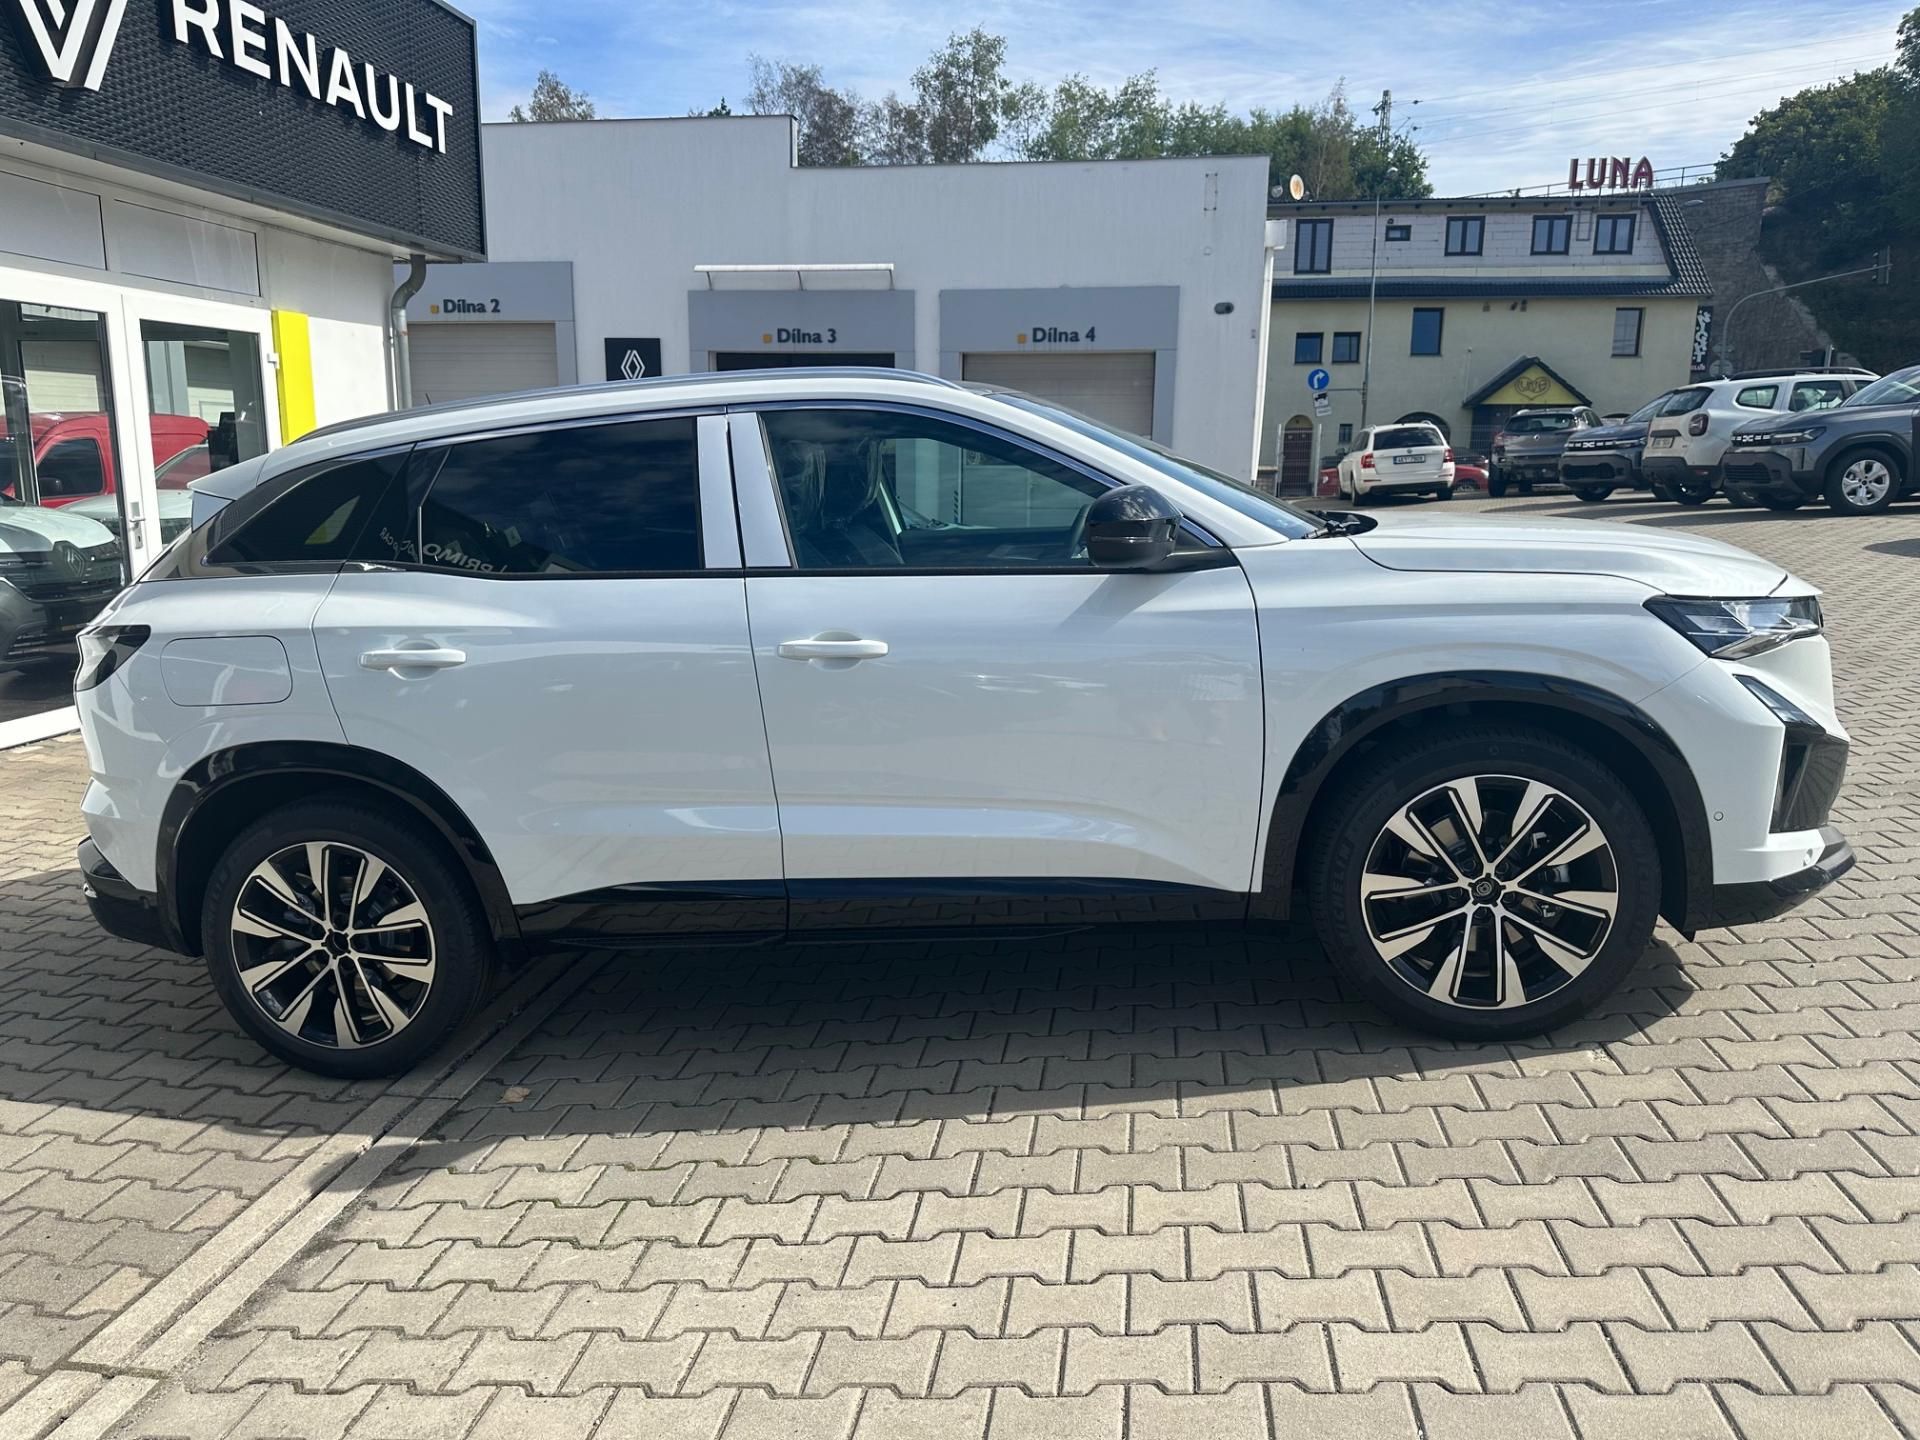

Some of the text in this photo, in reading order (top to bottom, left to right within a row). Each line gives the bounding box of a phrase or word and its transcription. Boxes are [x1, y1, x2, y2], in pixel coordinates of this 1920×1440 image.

[173, 0, 453, 154] RENAULT
[1568, 156, 1653, 190] LUNA
[443, 299, 501, 313] Dílna 2
[777, 328, 837, 343] Dílna 3
[1032, 326, 1096, 343] Dílna 4
